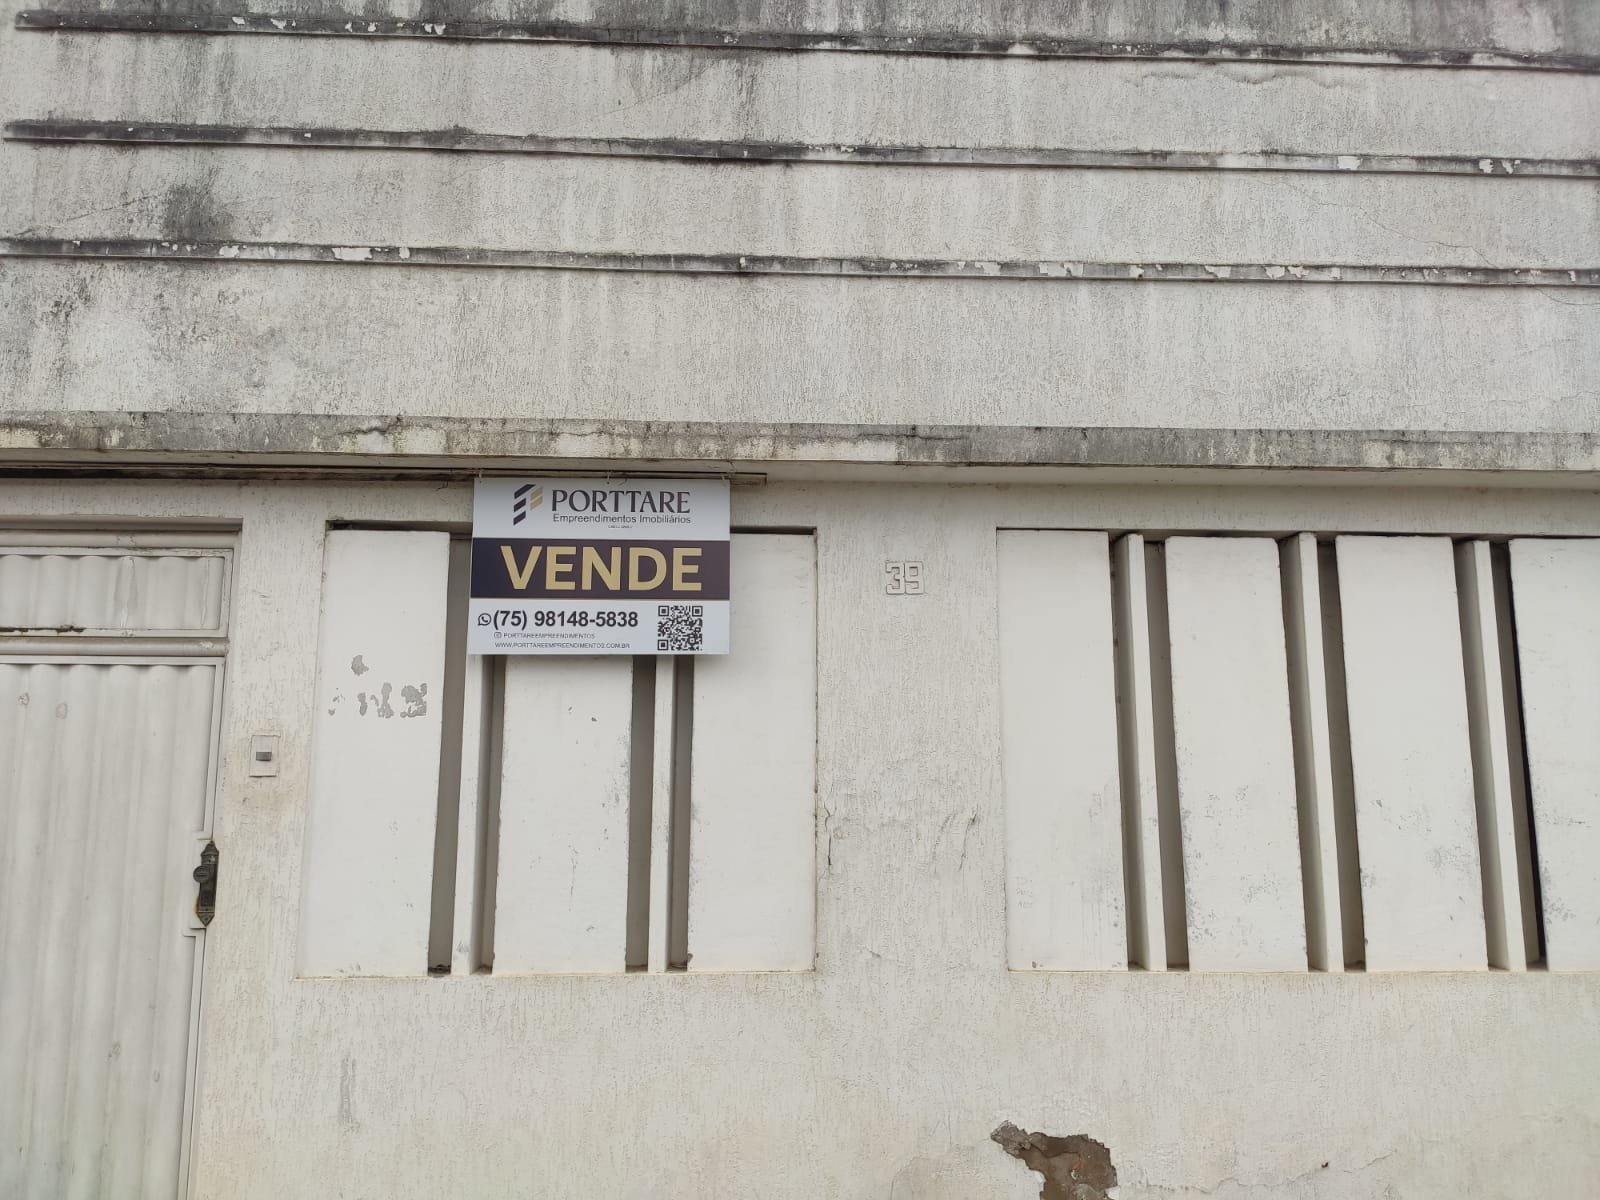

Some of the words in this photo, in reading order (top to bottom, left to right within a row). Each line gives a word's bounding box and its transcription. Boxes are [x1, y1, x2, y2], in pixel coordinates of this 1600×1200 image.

[551, 489, 691, 513] PORTTARE
[552, 513, 637, 525] Empreendimentos
[639, 514, 692, 524] Imobiliários
[500, 545, 703, 592] VENDE
[885, 560, 925, 595] 39
[493, 610, 528, 630] (75)
[534, 611, 639, 628] 98148-5838
